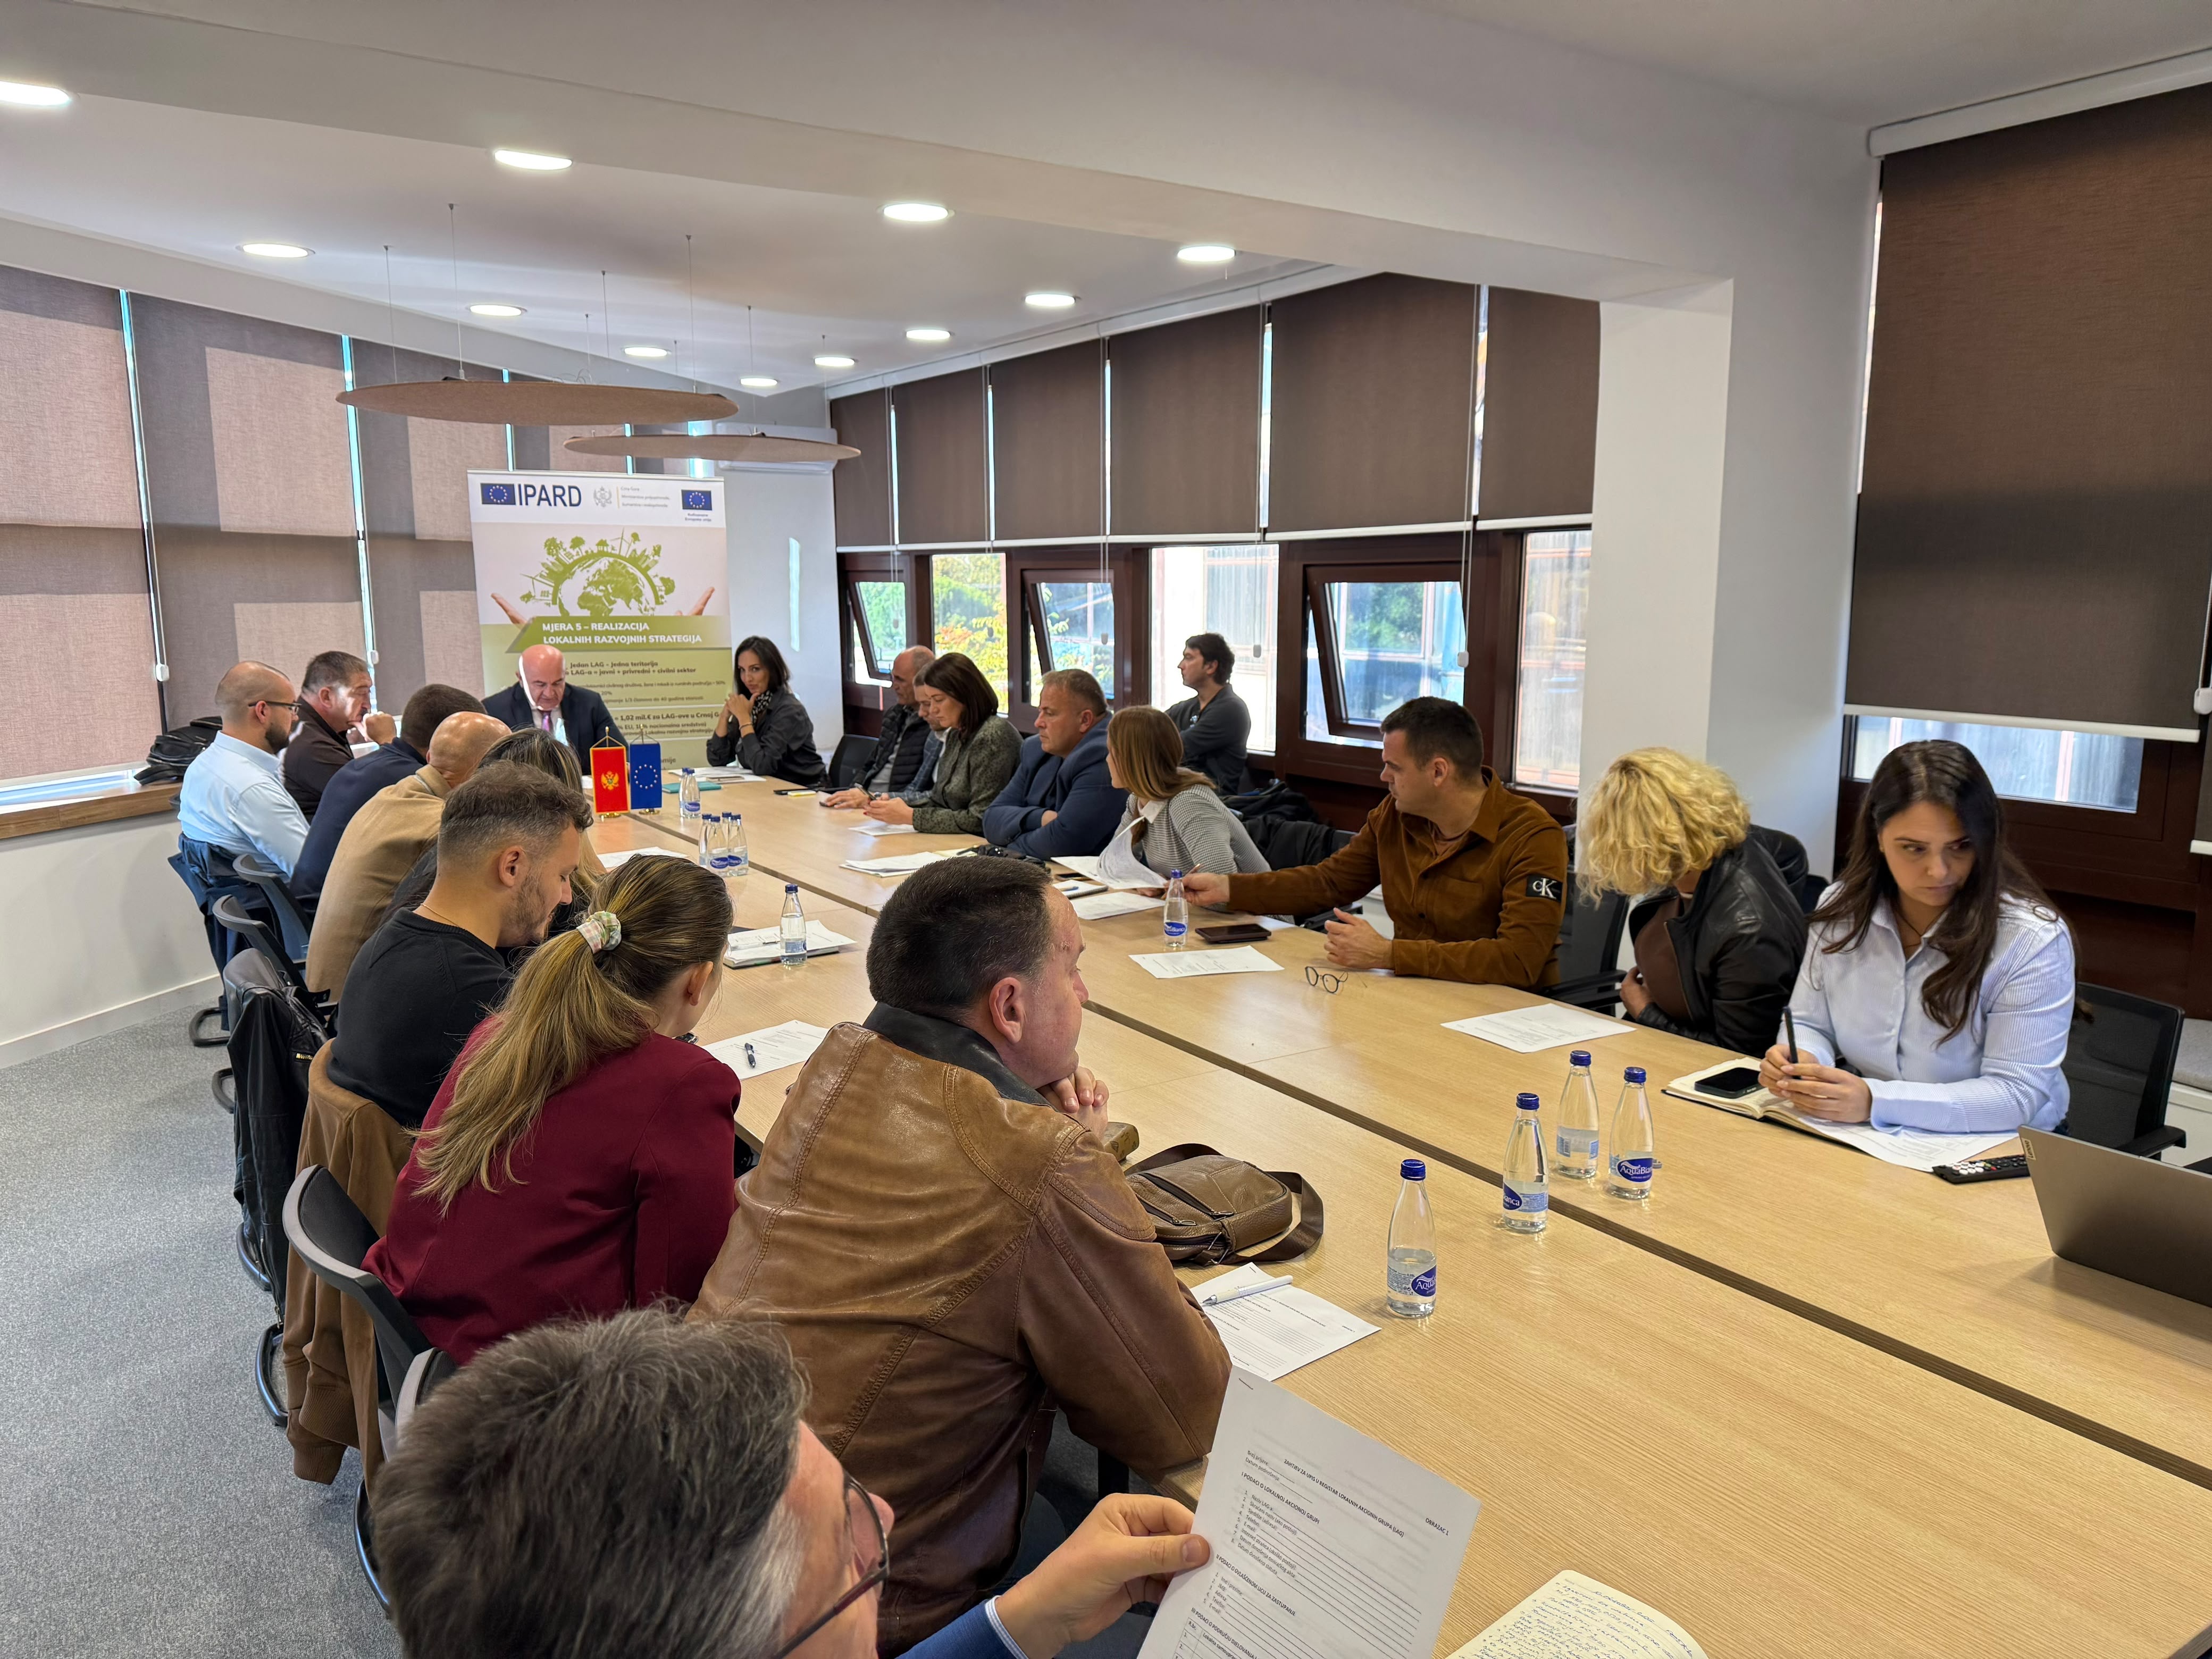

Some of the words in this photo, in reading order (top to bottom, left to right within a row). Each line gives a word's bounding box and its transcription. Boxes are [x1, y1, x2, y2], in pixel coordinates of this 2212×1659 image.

[517, 484, 582, 507] IPARD
[542, 623, 574, 632] MJERA
[591, 622, 649, 632] REALIZACIJA
[594, 635, 647, 644] RAZVOJNIH
[648, 635, 702, 644] STRATEGIJA
[2024, 1140, 2034, 1158] Lenovo
[1245, 1457, 1258, 1467] Datum
[1244, 1473, 1259, 1485] PODACI
[1264, 1486, 1285, 1501] LOKALNOJ
[1285, 1499, 1305, 1515] AKCIONOJ
[1306, 1513, 1319, 1523] GRUPI
[1319, 1481, 1338, 1495] REGISTAR
[1358, 1505, 1377, 1520] AKCIONIH
[1378, 1518, 1392, 1529] GRUPA
[1392, 1527, 1404, 1537] (LAG)
[1219, 1556, 1231, 1568] PODACI
[1257, 1586, 1266, 1595] LICU
[1271, 1596, 1295, 1615] ZASTUPANJE
[1195, 1611, 1208, 1623] PODACI
[1216, 1643, 1237, 1659] samoupra
